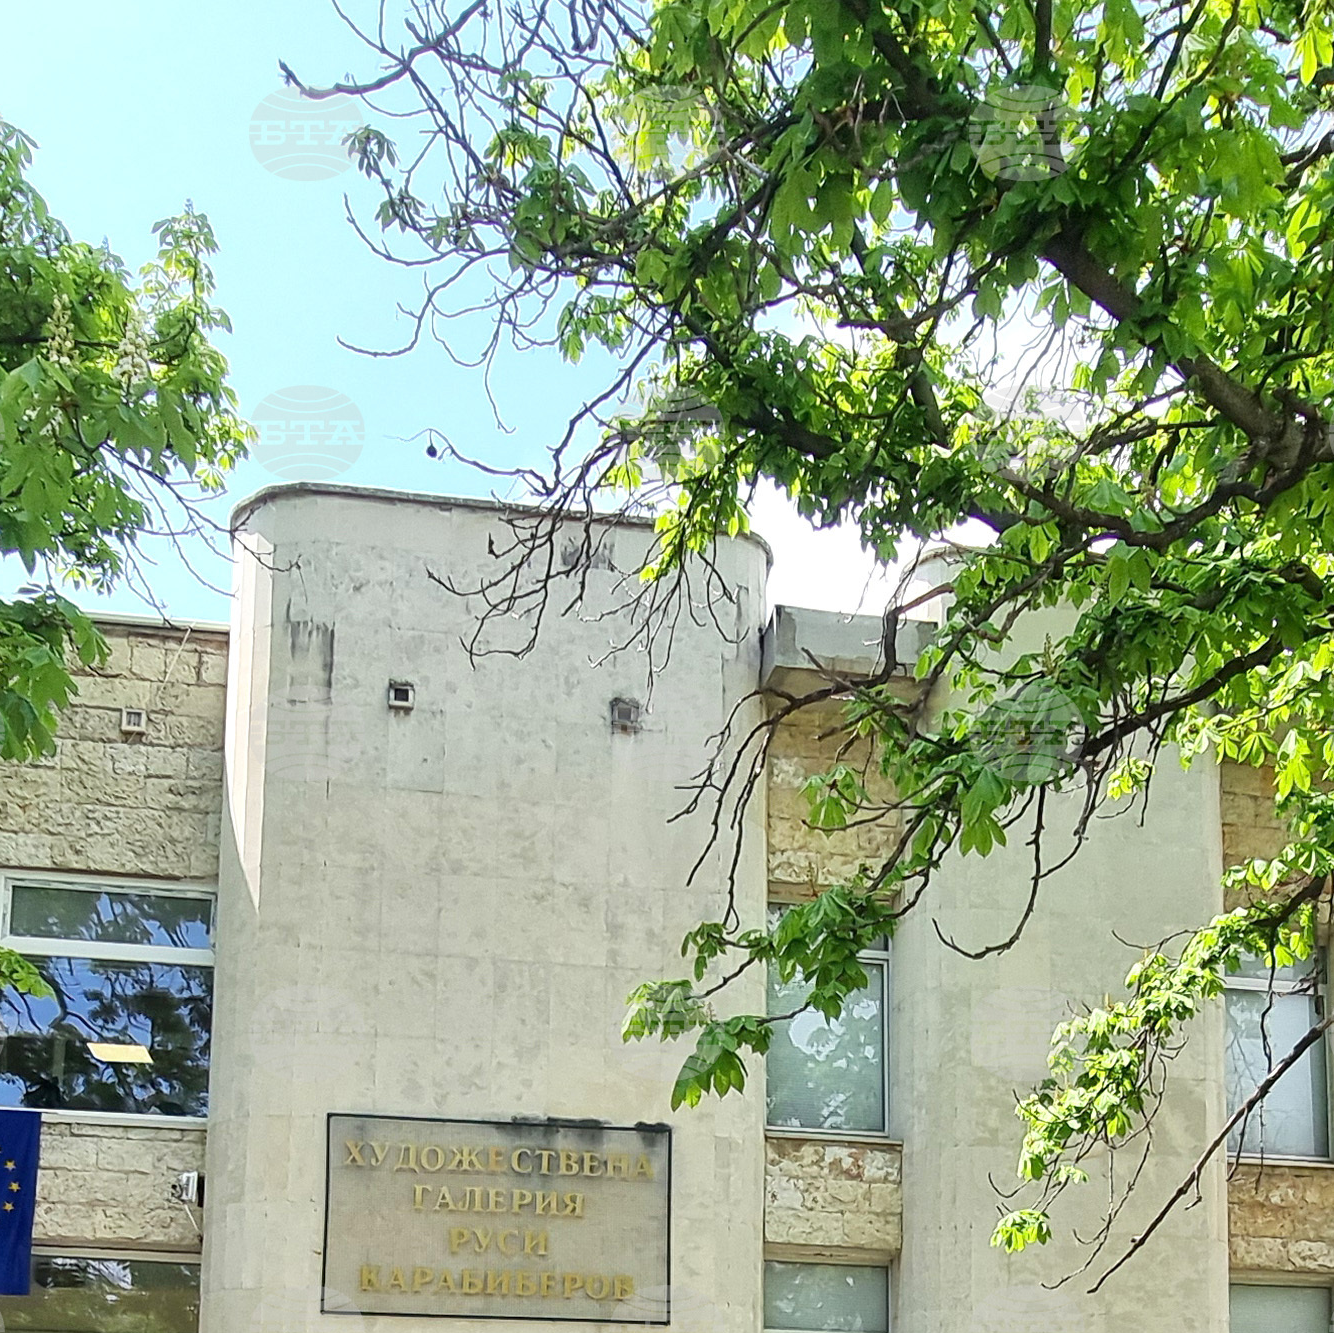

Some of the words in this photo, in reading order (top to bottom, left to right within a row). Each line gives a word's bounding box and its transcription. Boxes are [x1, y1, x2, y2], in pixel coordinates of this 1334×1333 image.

[343, 1140, 655, 1180] ХУДОЖЕСТВЕНА
[413, 1184, 585, 1217] ГАЛЕРИЯ
[449, 1226, 549, 1257] РУСИ
[359, 1264, 634, 1301] КАРАБИБЕРОВ
